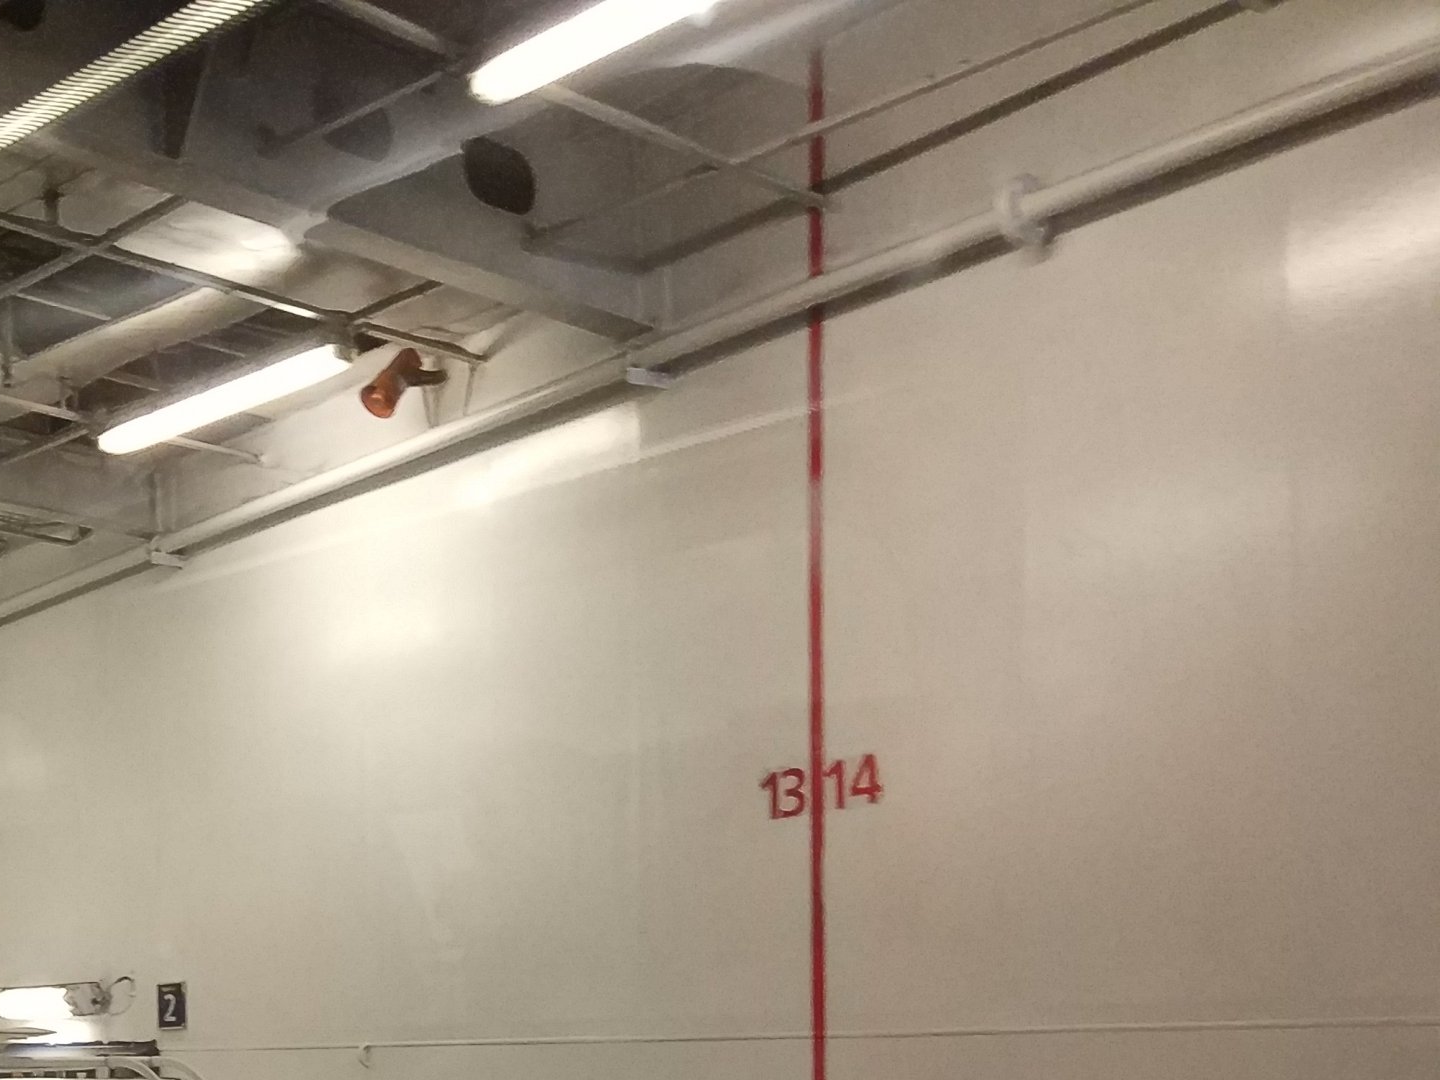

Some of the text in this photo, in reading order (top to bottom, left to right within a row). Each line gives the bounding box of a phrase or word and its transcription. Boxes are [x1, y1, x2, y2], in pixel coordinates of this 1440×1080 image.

[759, 767, 806, 820] 13
[823, 753, 884, 810] 14
[164, 994, 177, 1022] 2
